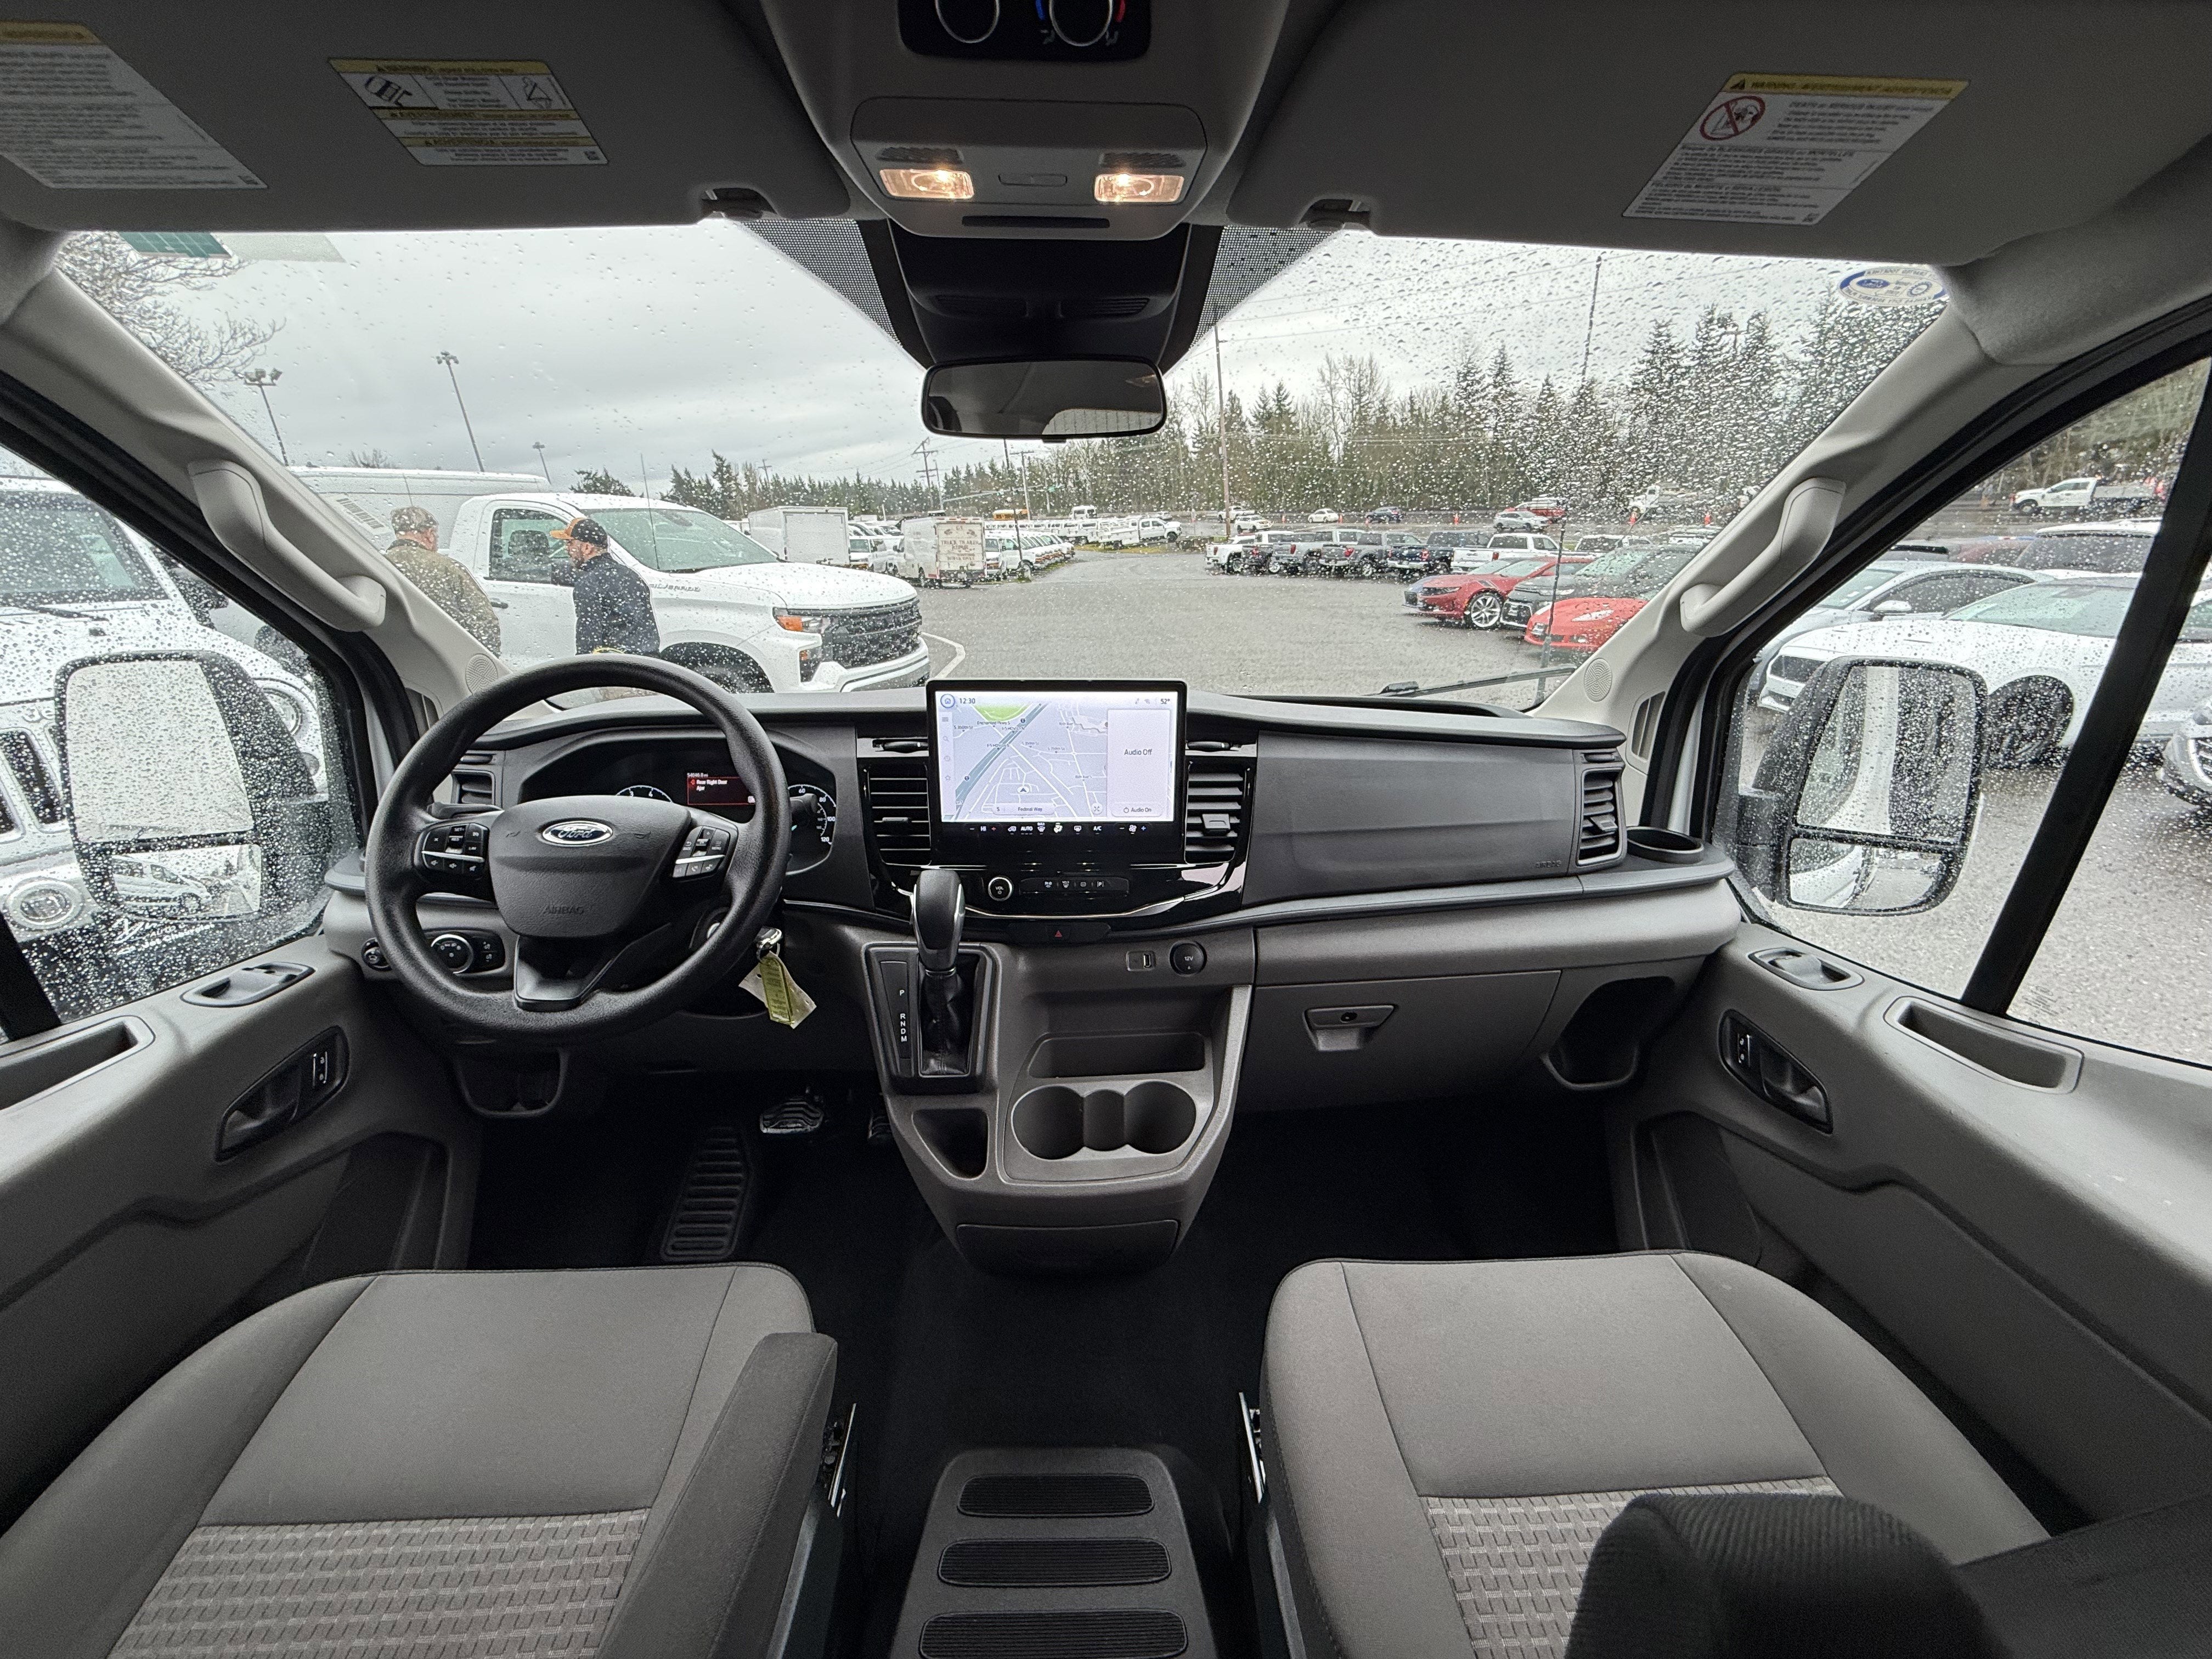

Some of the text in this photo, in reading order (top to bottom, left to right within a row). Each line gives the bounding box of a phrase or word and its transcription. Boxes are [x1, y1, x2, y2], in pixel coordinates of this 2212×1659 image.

[558, 825, 595, 838] Ford
[1536, 860, 1562, 868] AIRBAG
[542, 905, 585, 915] AIRBAG
